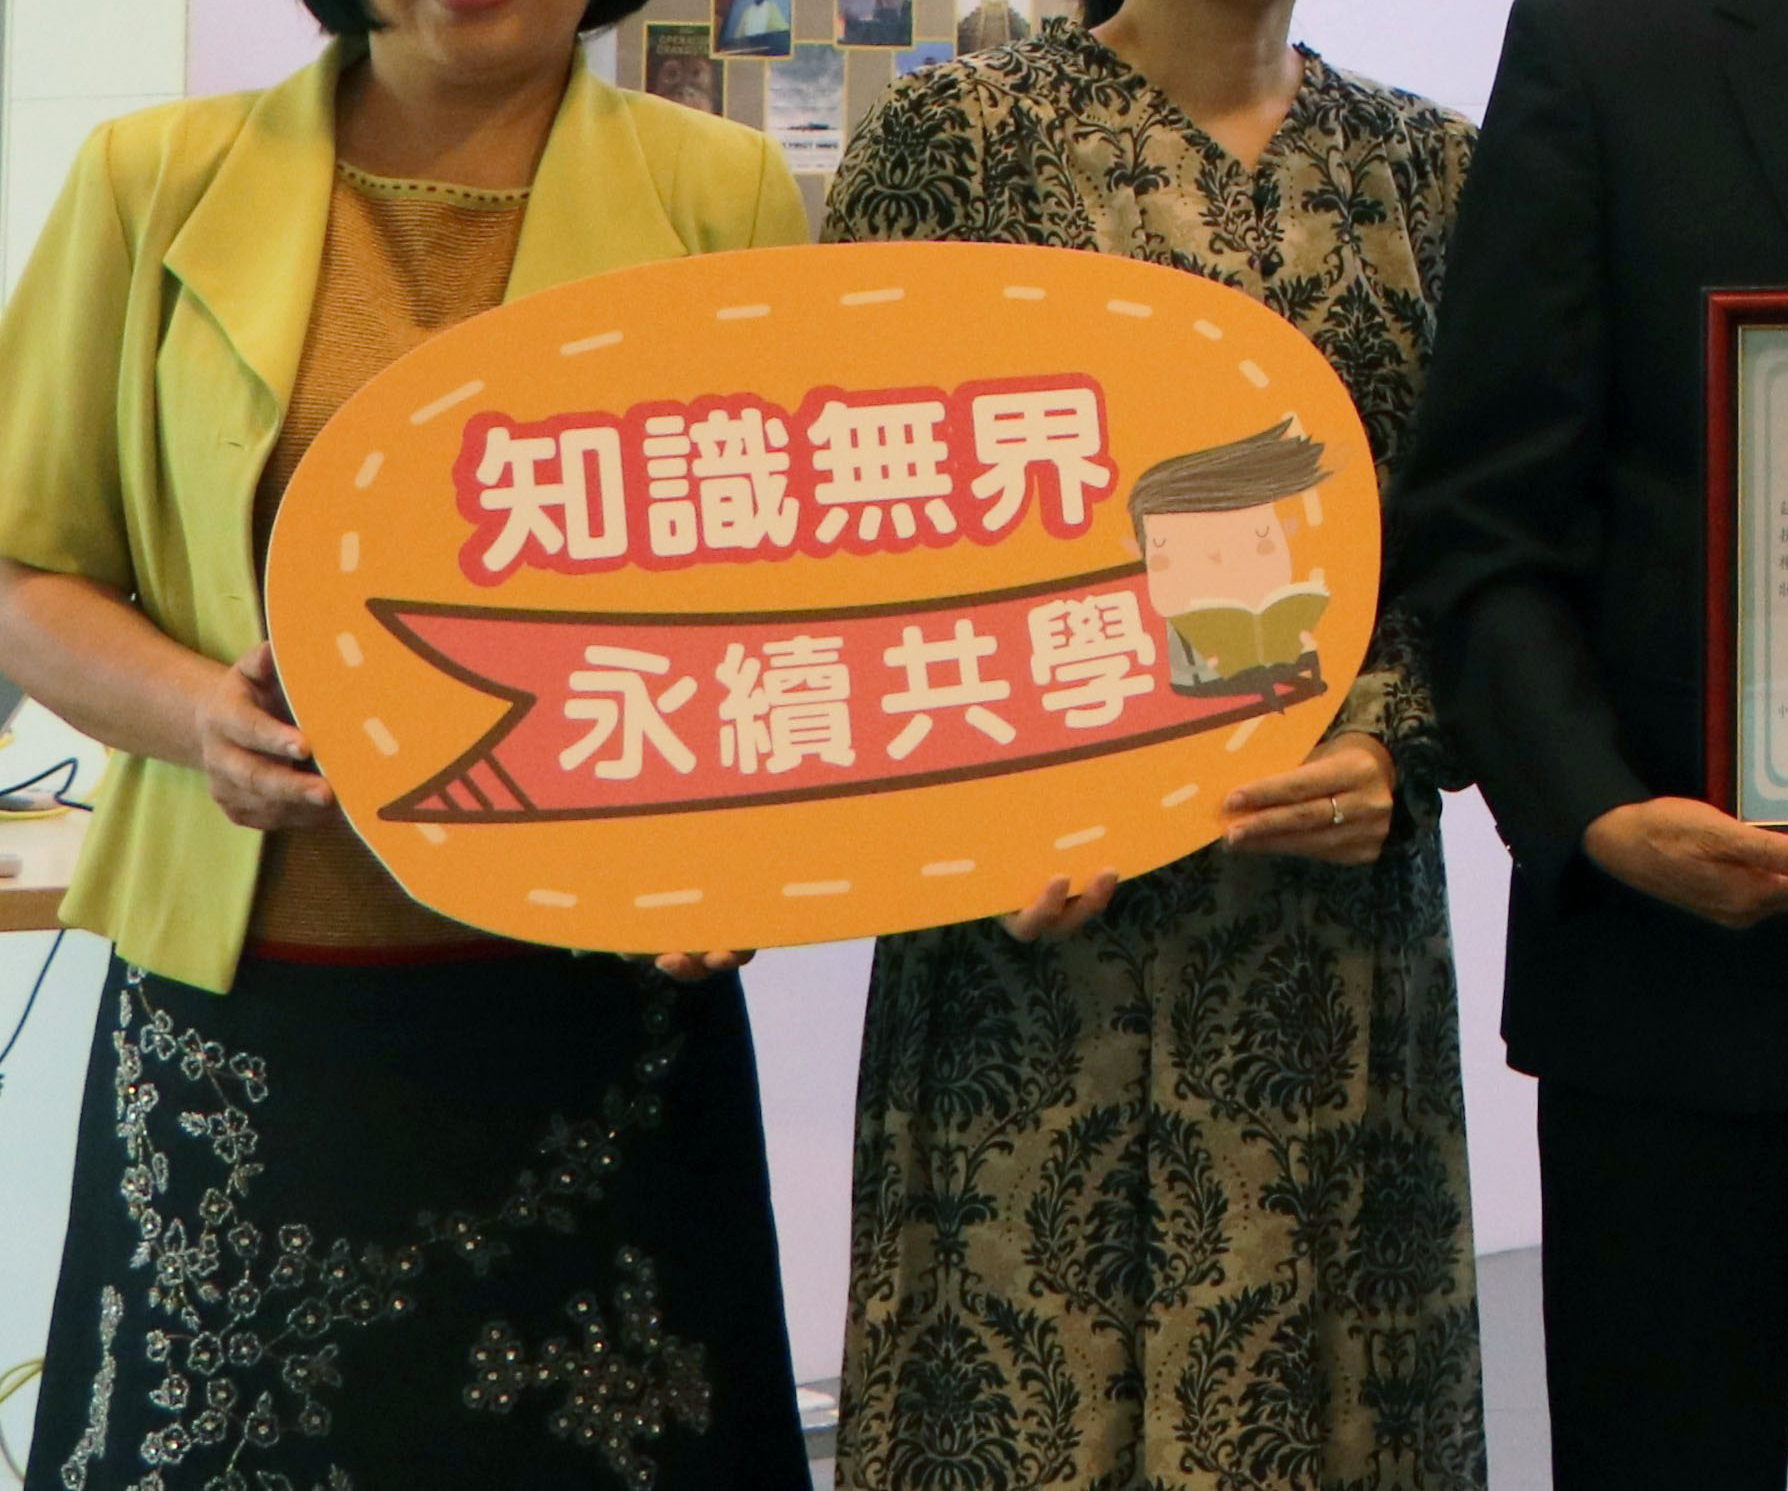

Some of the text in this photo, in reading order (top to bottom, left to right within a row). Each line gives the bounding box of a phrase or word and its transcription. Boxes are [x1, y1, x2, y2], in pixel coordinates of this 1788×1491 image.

[474, 386, 1111, 573] 知識無界
[557, 588, 1156, 780] 永續共學
